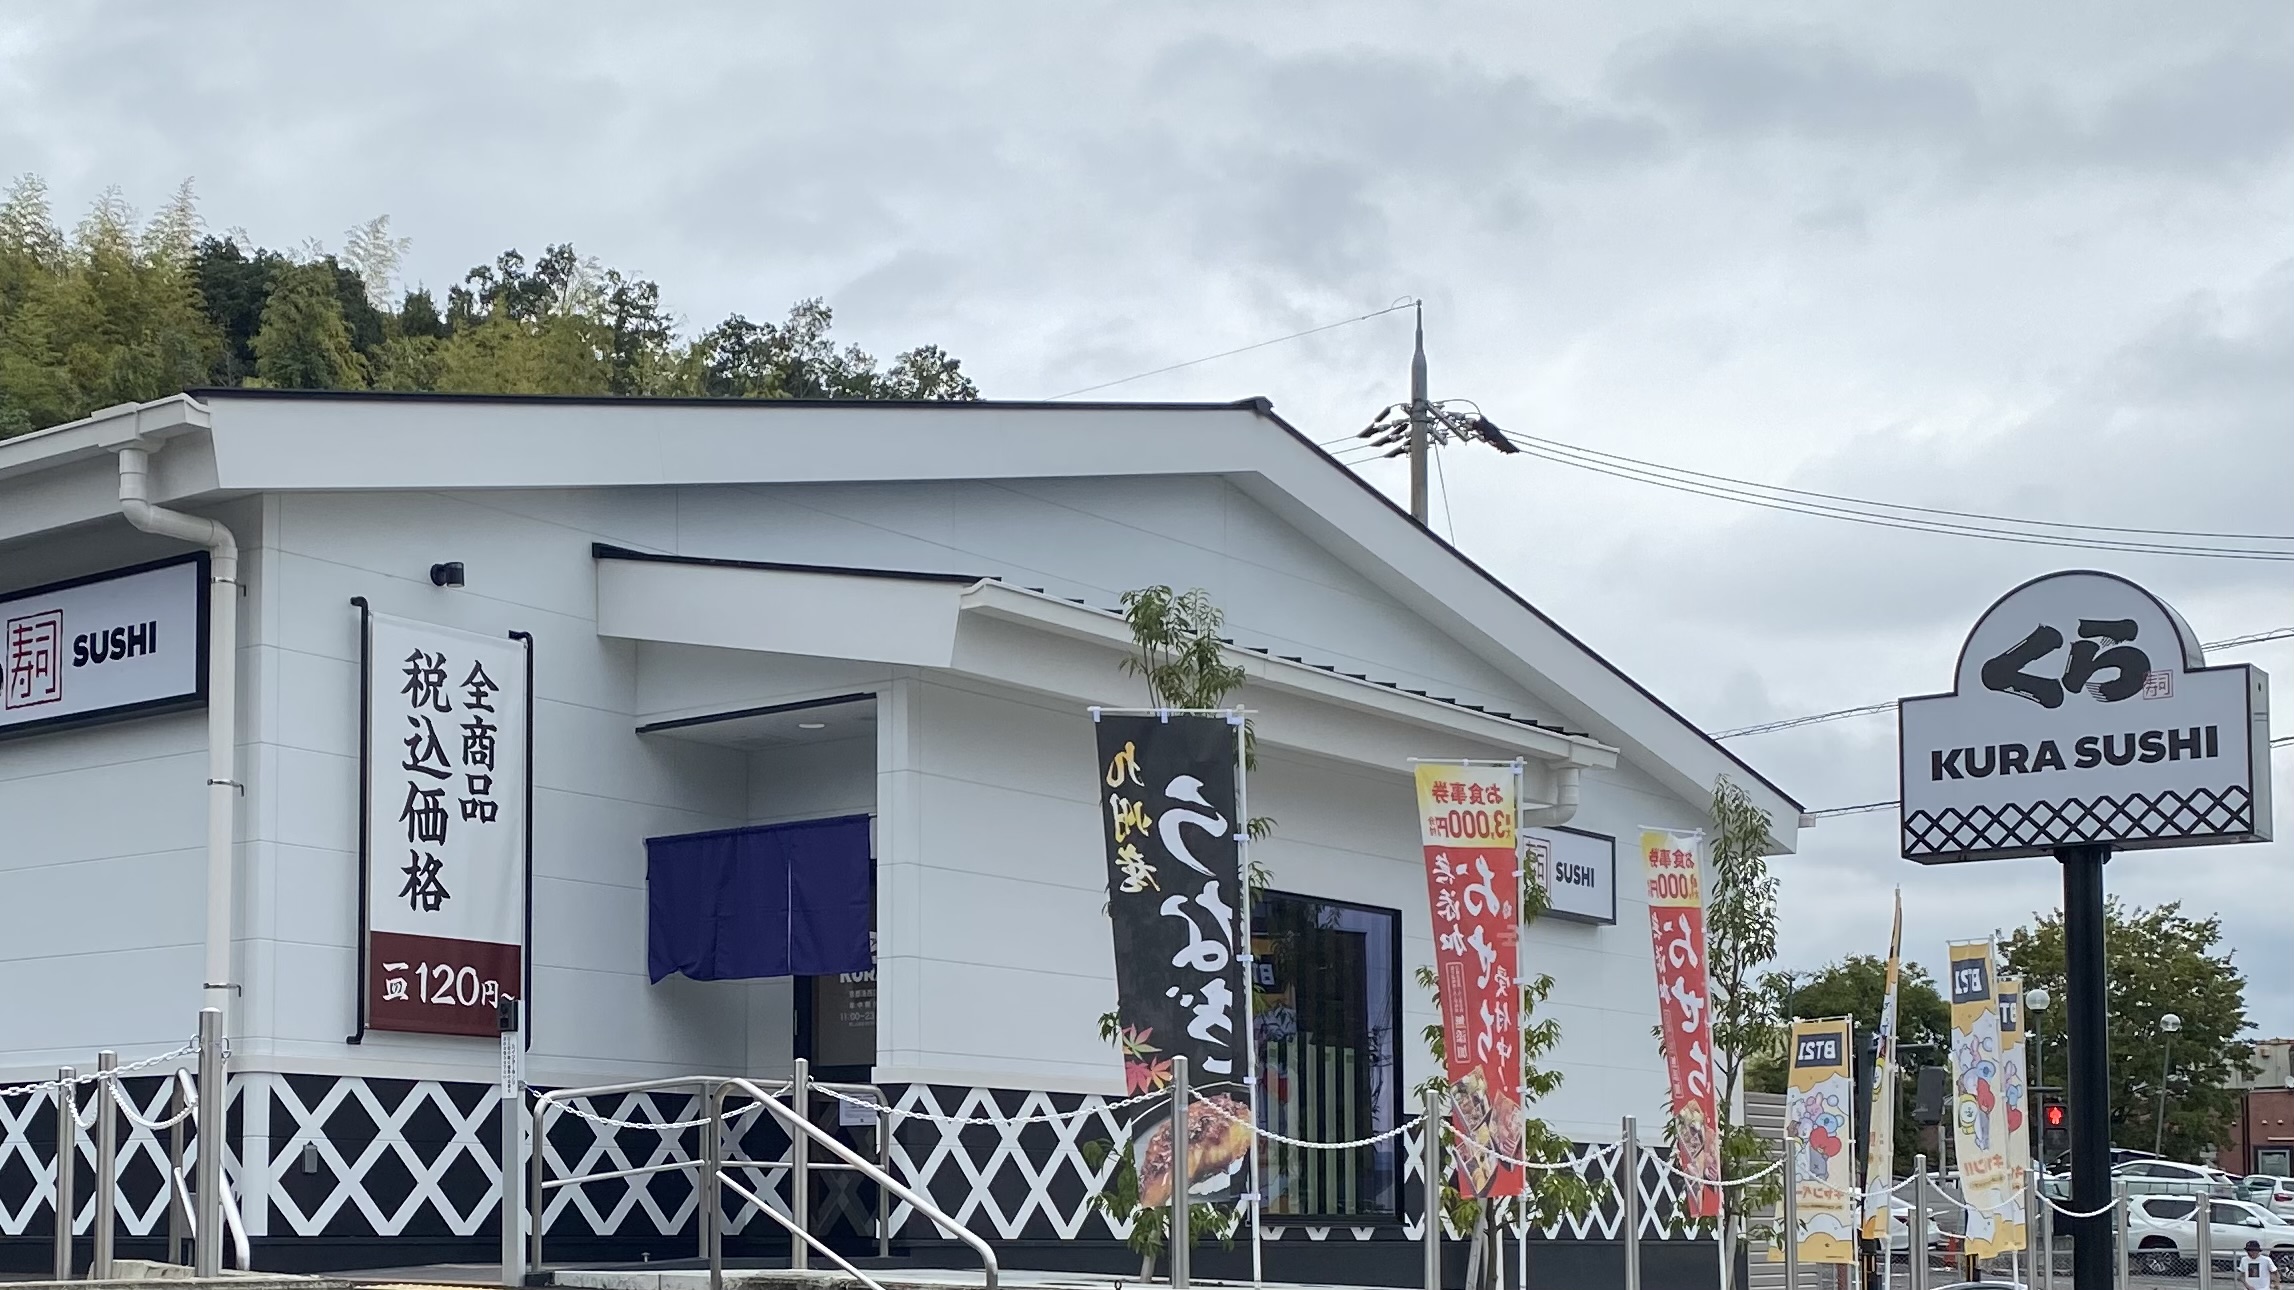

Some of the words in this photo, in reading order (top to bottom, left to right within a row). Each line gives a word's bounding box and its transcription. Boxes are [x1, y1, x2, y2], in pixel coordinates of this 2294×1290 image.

[73, 621, 157, 668] SUSHI
[1981, 618, 2151, 709] くら
[458, 660, 499, 824] 全商品
[1931, 740, 2067, 781] KURA
[2073, 725, 2219, 769] SUSHI
[398, 648, 453, 913] 税込価格
[1556, 862, 1595, 888] SUSHI
[840, 968, 877, 983] KUR
